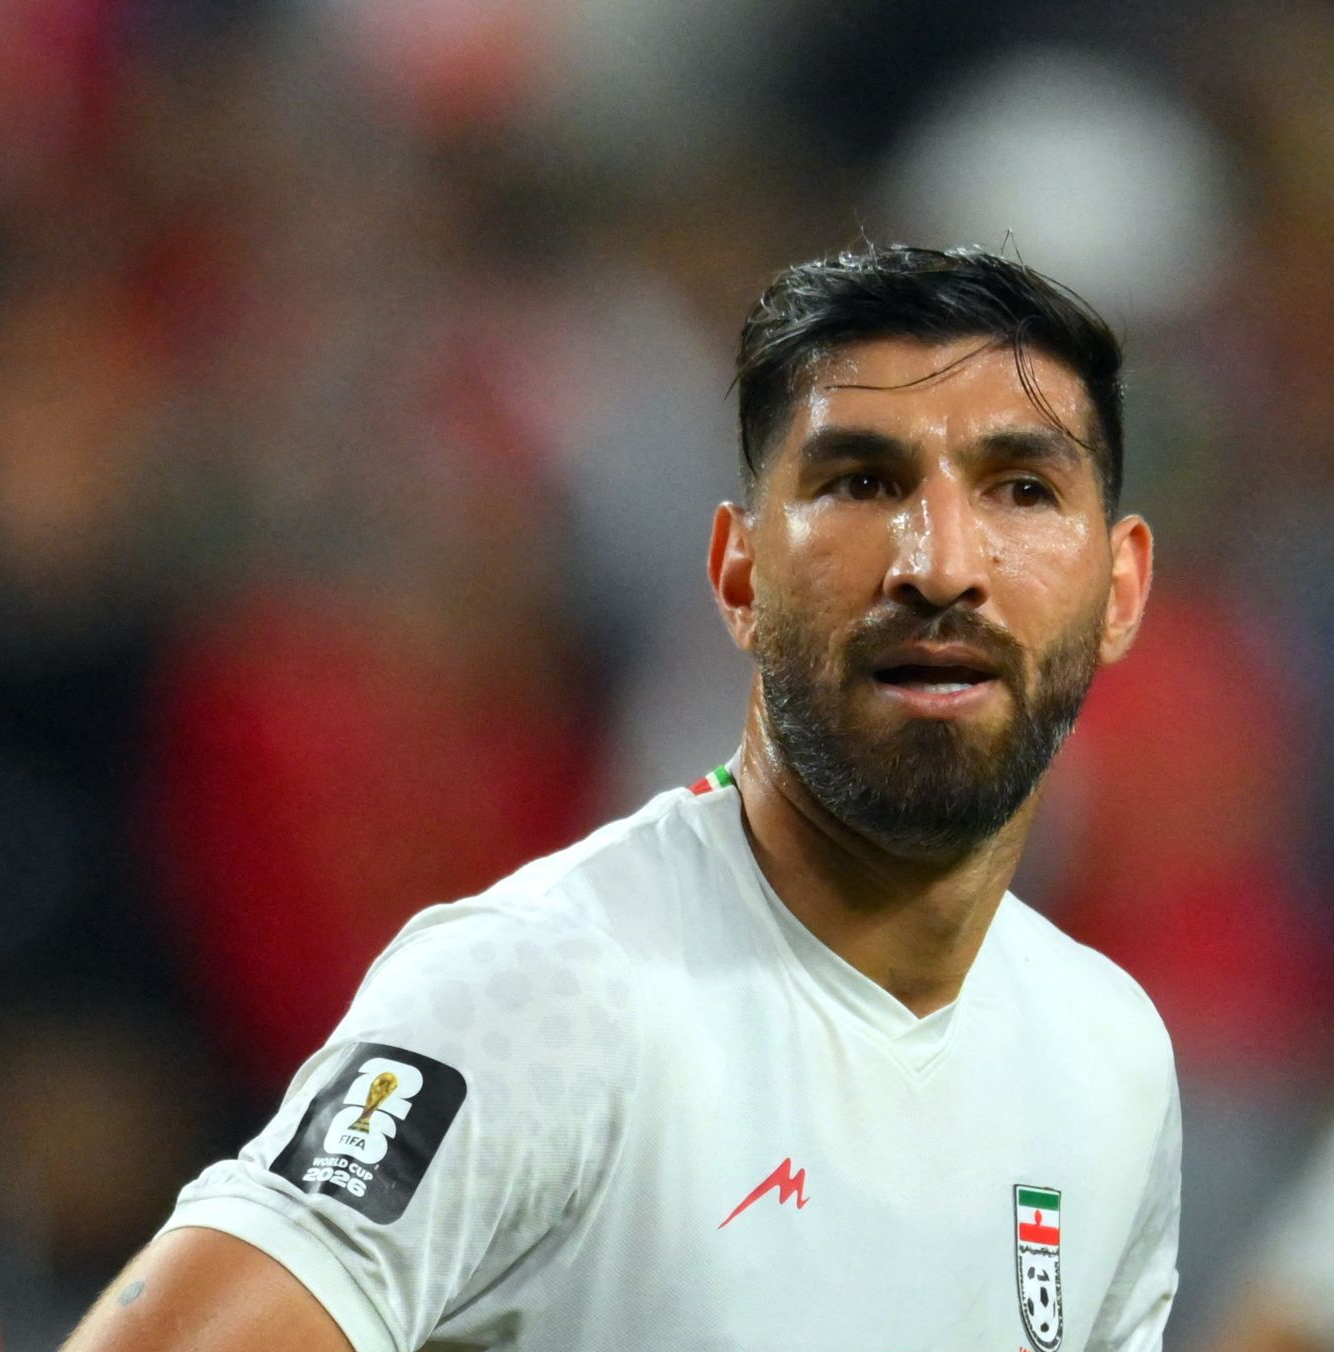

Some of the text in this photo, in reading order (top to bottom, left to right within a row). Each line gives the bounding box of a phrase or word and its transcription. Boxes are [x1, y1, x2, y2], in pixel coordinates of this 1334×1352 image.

[339, 1135, 366, 1150] FIFA
[313, 1157, 373, 1181] WORLD CUP
[302, 1167, 367, 1197] 2026
